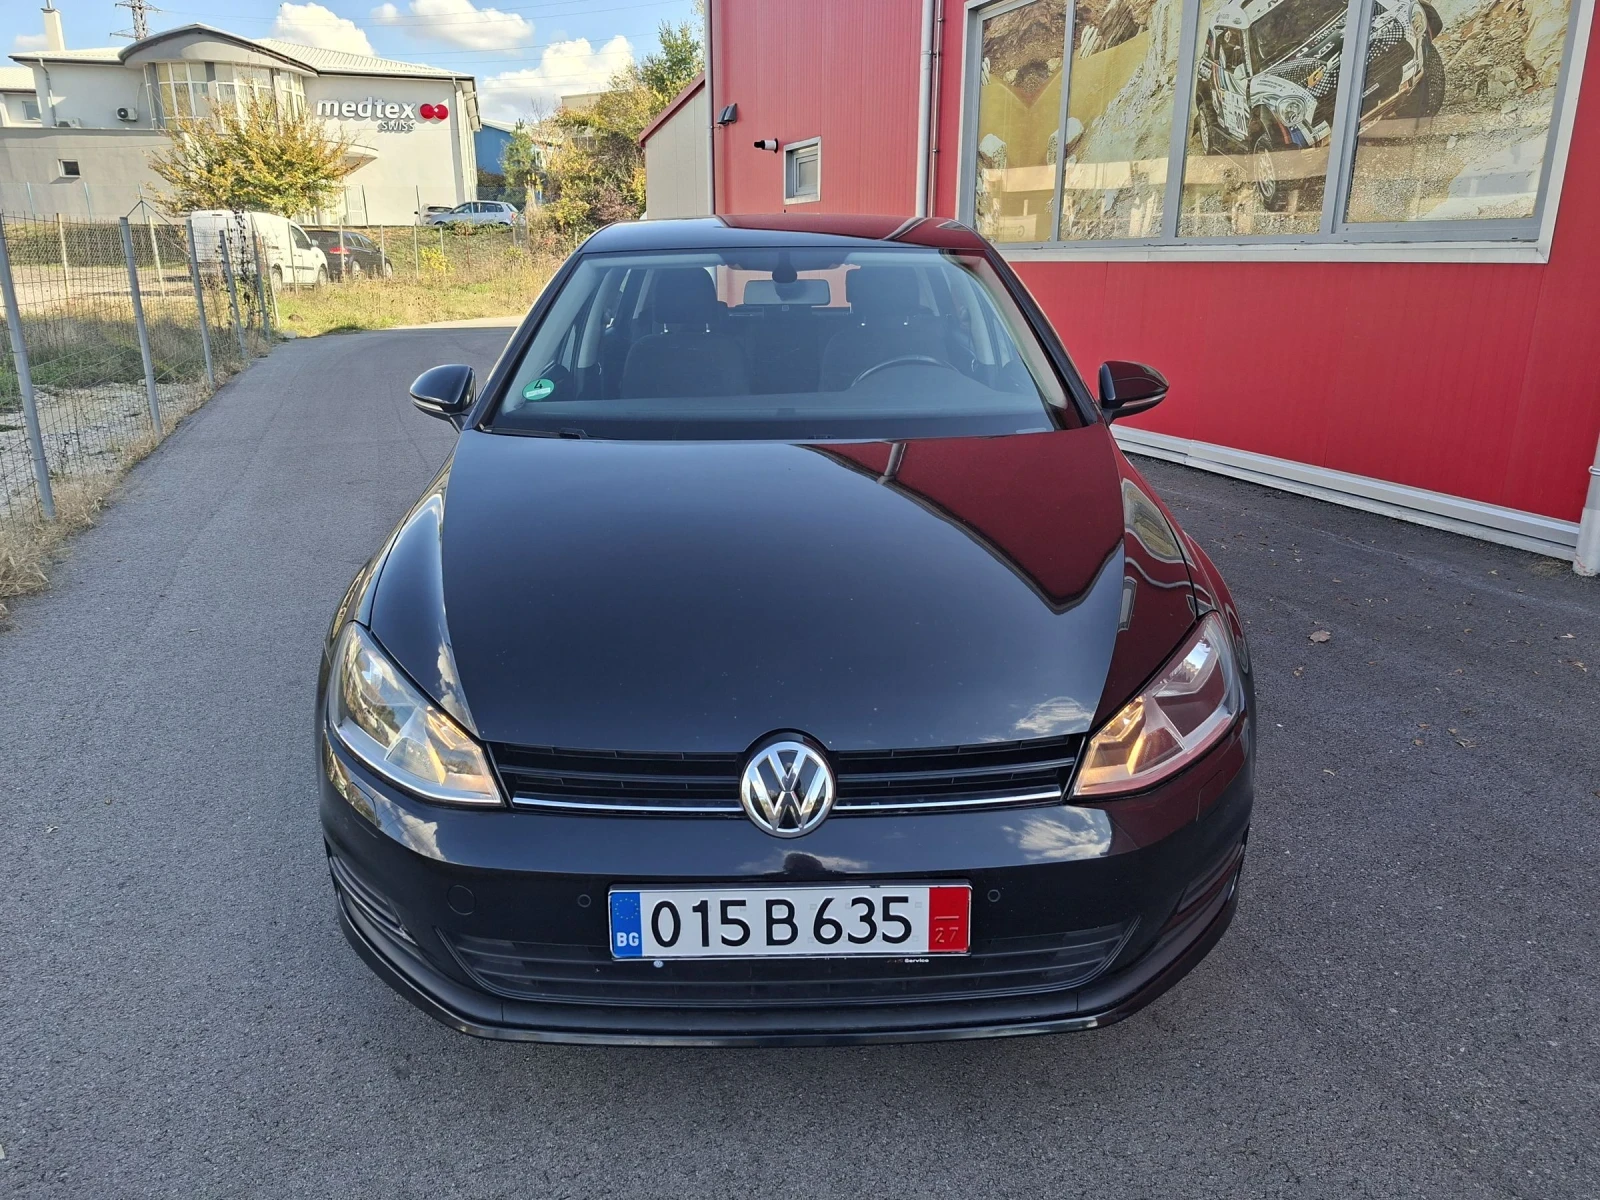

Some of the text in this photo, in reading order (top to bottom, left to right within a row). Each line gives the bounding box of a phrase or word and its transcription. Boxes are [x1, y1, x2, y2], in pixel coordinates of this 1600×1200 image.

[316, 96, 416, 119] medtex
[380, 120, 416, 132] SWISS
[533, 379, 544, 390] 4
[650, 895, 913, 948] 015 B 635
[616, 931, 640, 947] BG
[934, 926, 959, 943] 27
